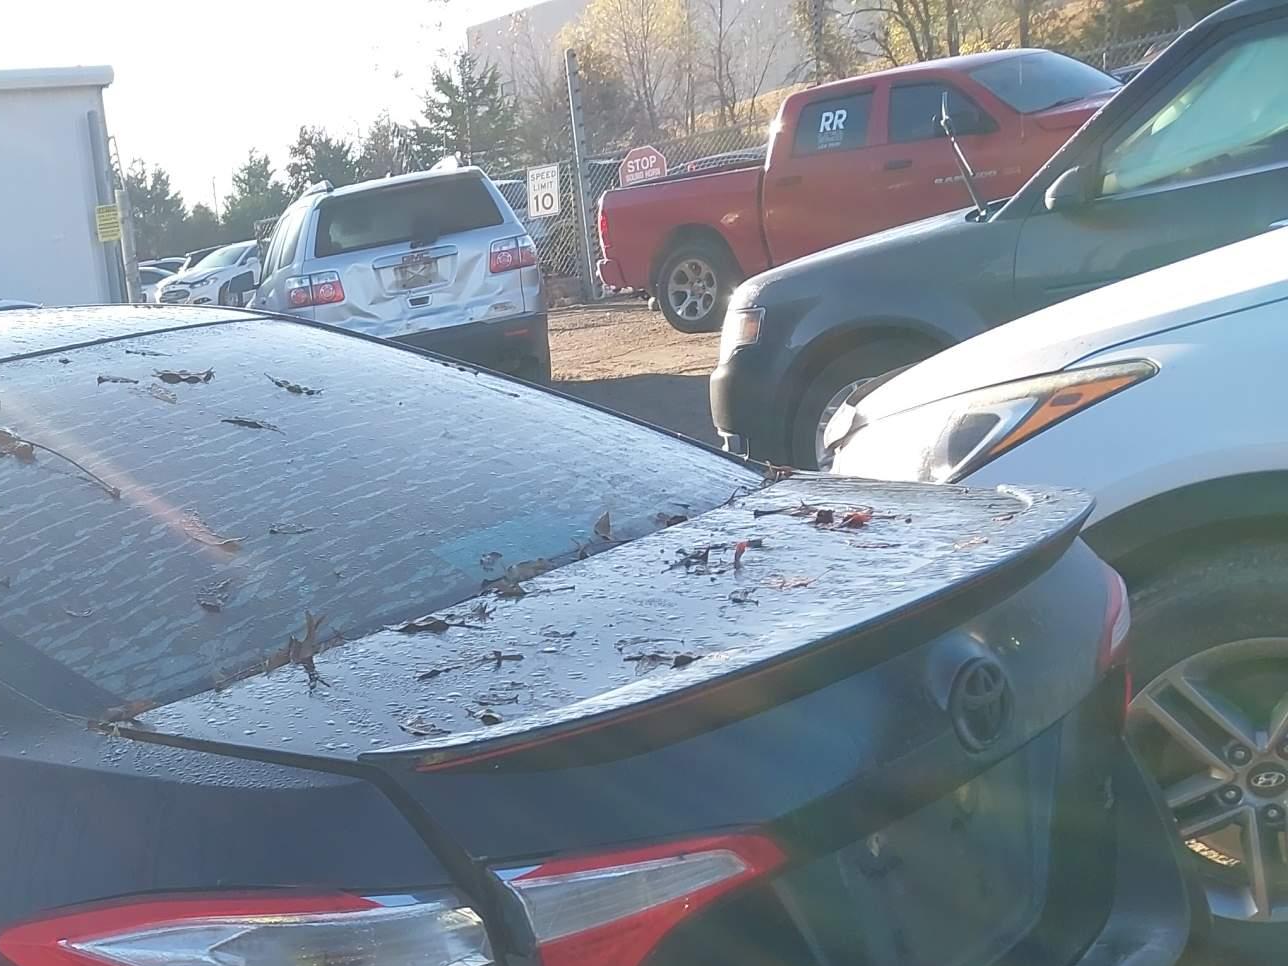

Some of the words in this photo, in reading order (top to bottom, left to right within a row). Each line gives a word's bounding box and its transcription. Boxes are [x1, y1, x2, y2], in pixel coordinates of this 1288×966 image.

[818, 109, 847, 133] RR
[627, 155, 657, 173] STOP
[530, 170, 557, 182] SPEED
[533, 181, 553, 192] LIMIT
[533, 192, 554, 213] 10
